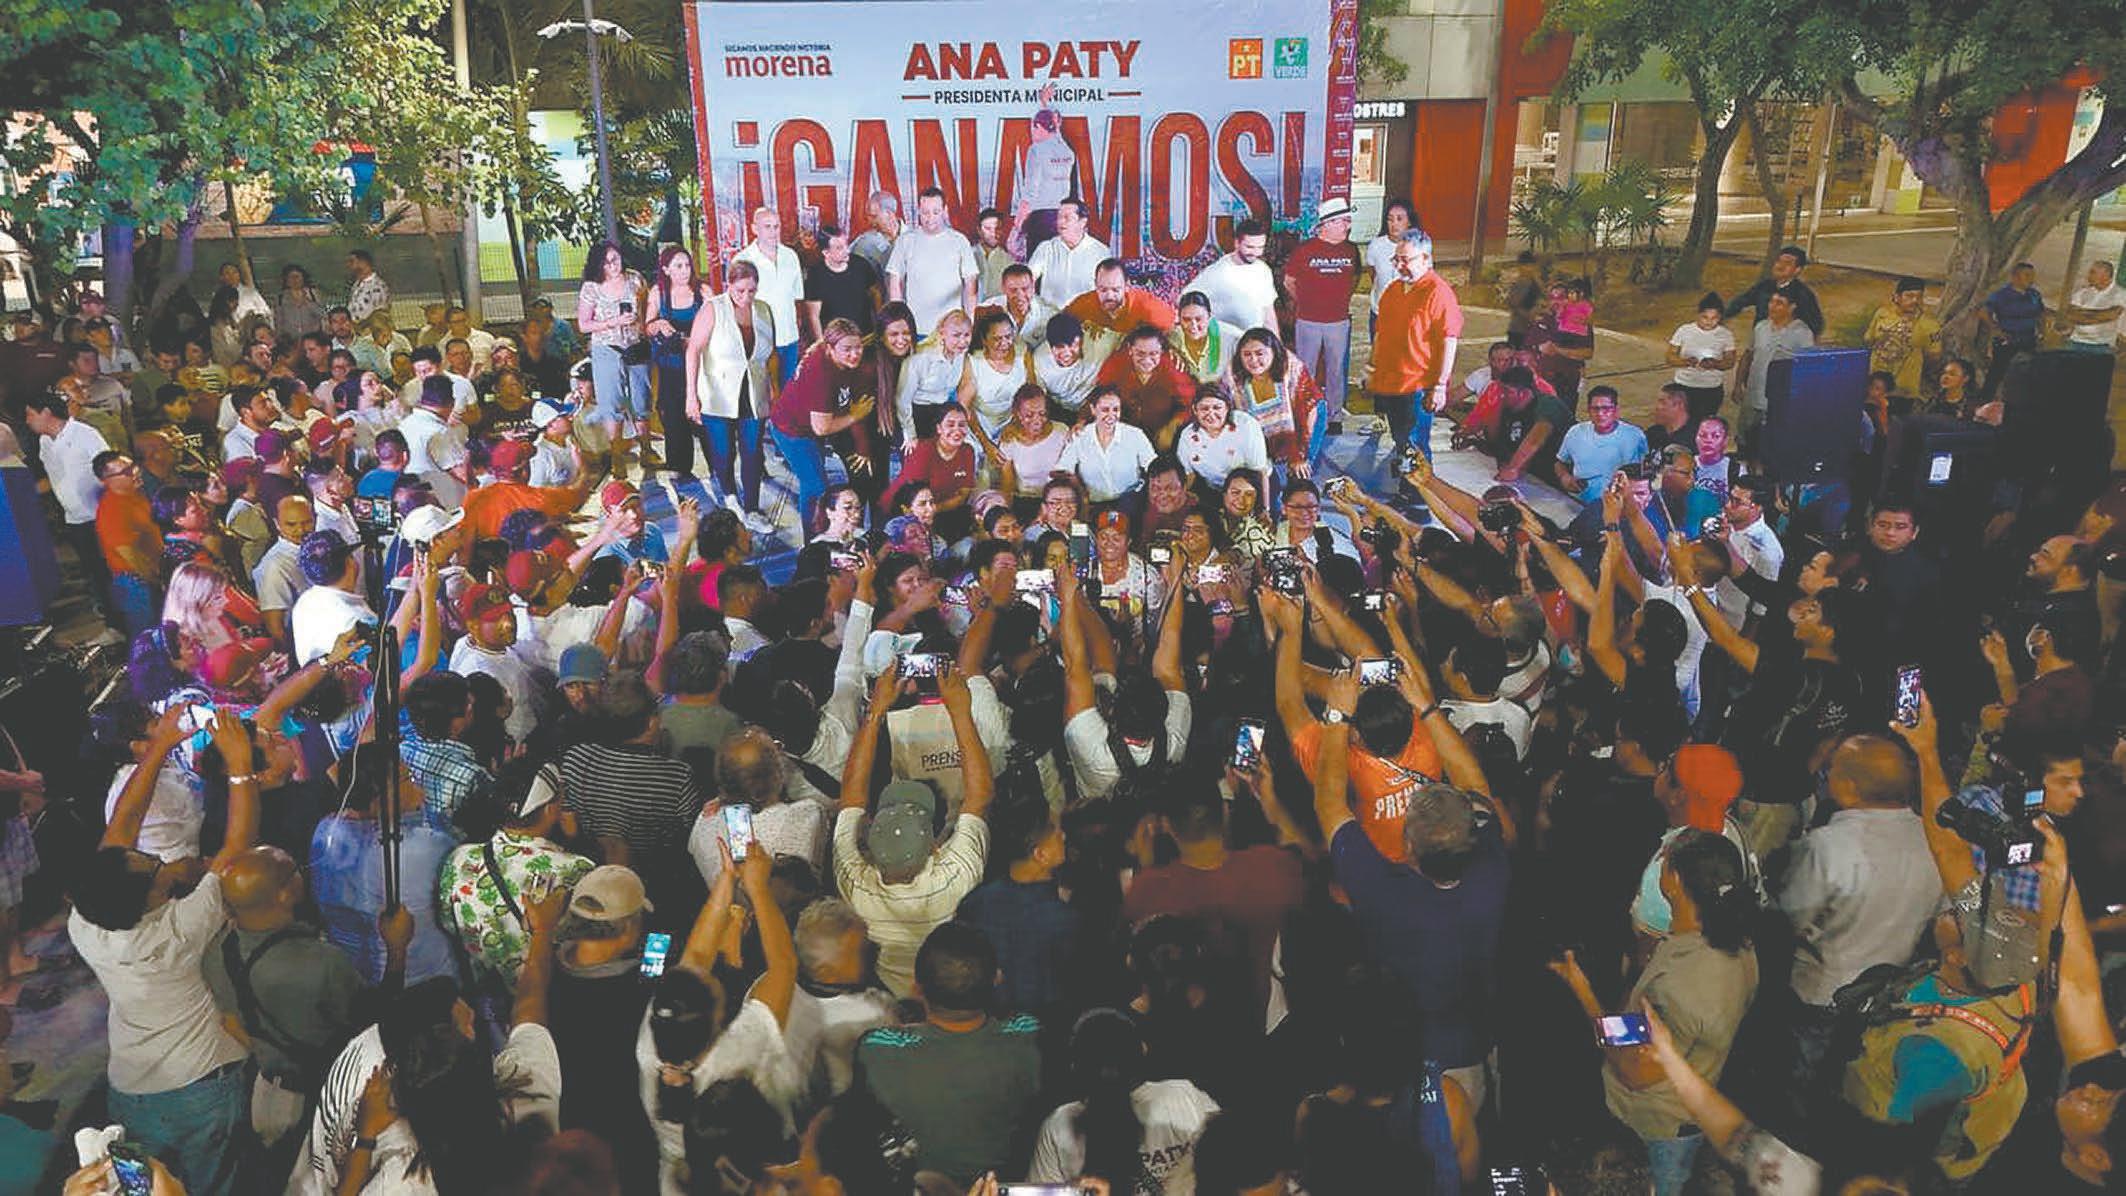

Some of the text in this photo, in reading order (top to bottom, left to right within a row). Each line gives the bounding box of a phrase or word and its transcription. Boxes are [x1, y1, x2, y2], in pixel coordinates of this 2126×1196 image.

[725, 54, 832, 78] morena
[903, 40, 1141, 80] ANA PATY
[1232, 55, 1259, 77] PT
[934, 88, 1104, 104] PRESIDENTA MNICIPAL
